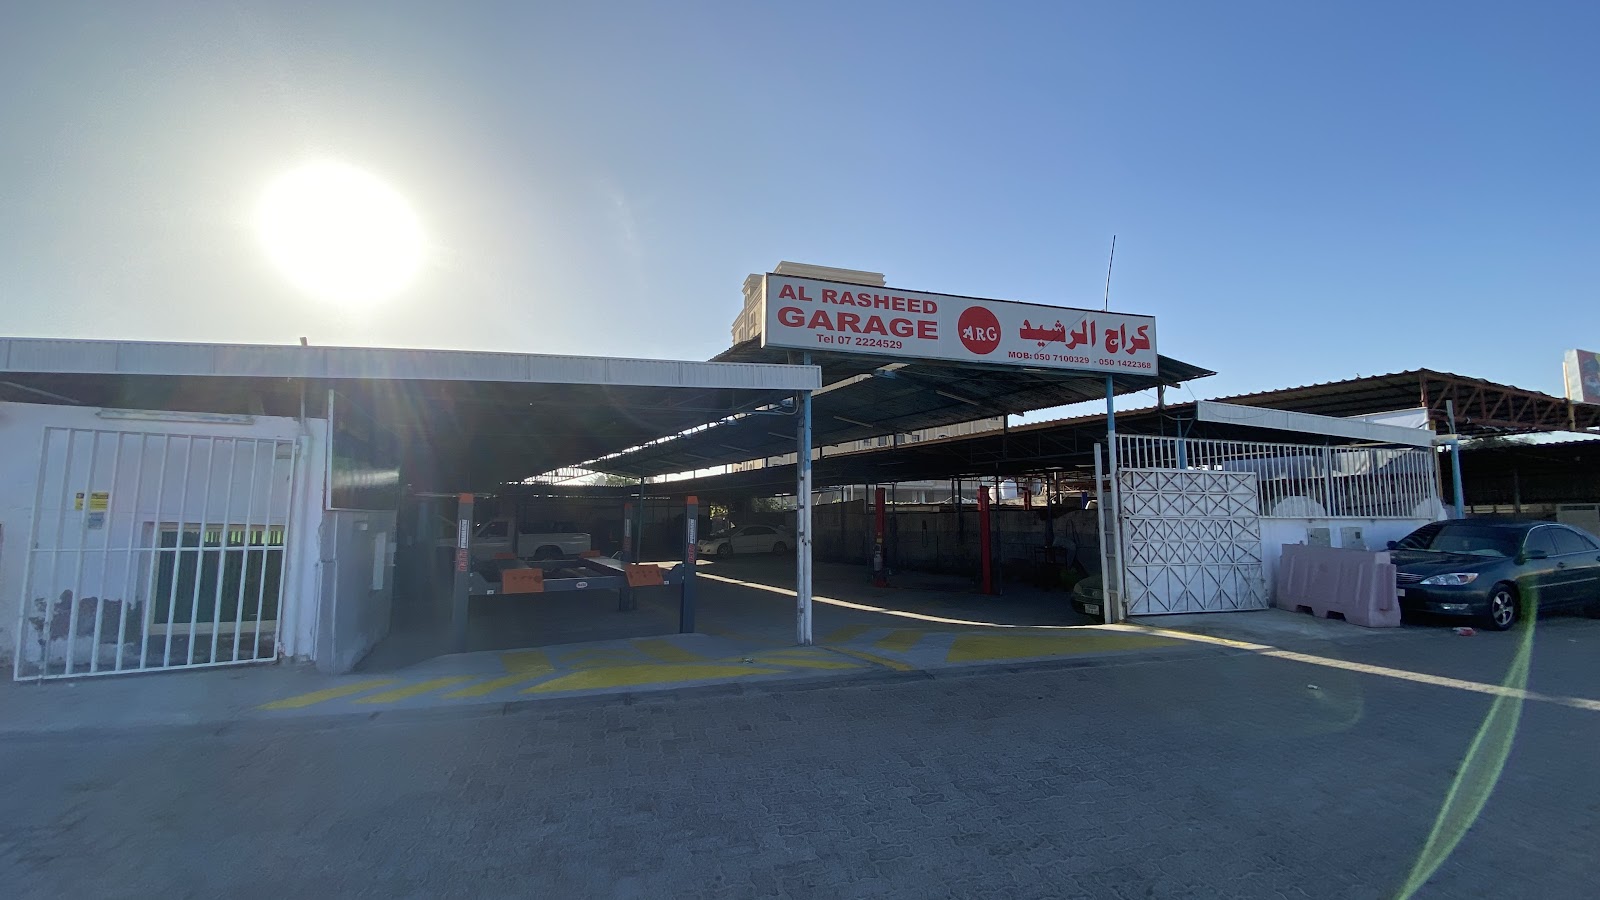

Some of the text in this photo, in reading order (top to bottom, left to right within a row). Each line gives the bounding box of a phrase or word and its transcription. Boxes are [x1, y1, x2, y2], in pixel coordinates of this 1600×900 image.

[778, 284, 938, 314] AL RASHEED
[777, 306, 938, 340] GARAGE
[963, 325, 998, 341] ARG
[816, 333, 903, 349] Tel 07 2224529
[1019, 319, 1150, 355] كراج الرشيد
[1033, 353, 1051, 361] 050
[1053, 354, 1090, 364] 7100329
[1099, 358, 1115, 366] 050
[1117, 359, 1152, 369] 1422368
